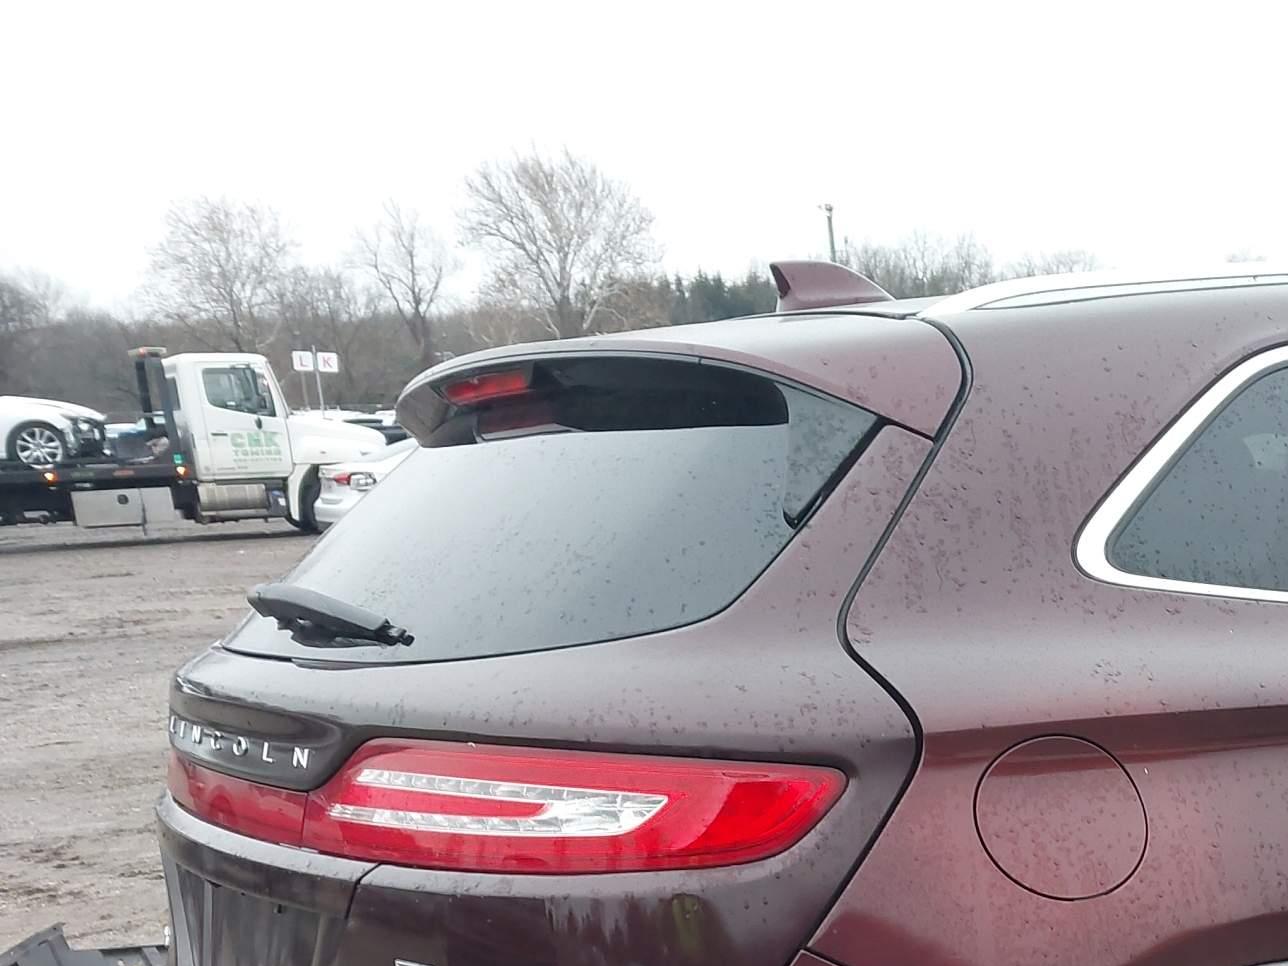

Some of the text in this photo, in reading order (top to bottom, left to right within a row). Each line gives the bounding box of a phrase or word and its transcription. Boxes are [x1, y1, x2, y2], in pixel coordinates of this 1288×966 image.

[299, 354, 310, 368] L
[322, 355, 334, 369] K
[170, 715, 310, 769] LINCOLN
